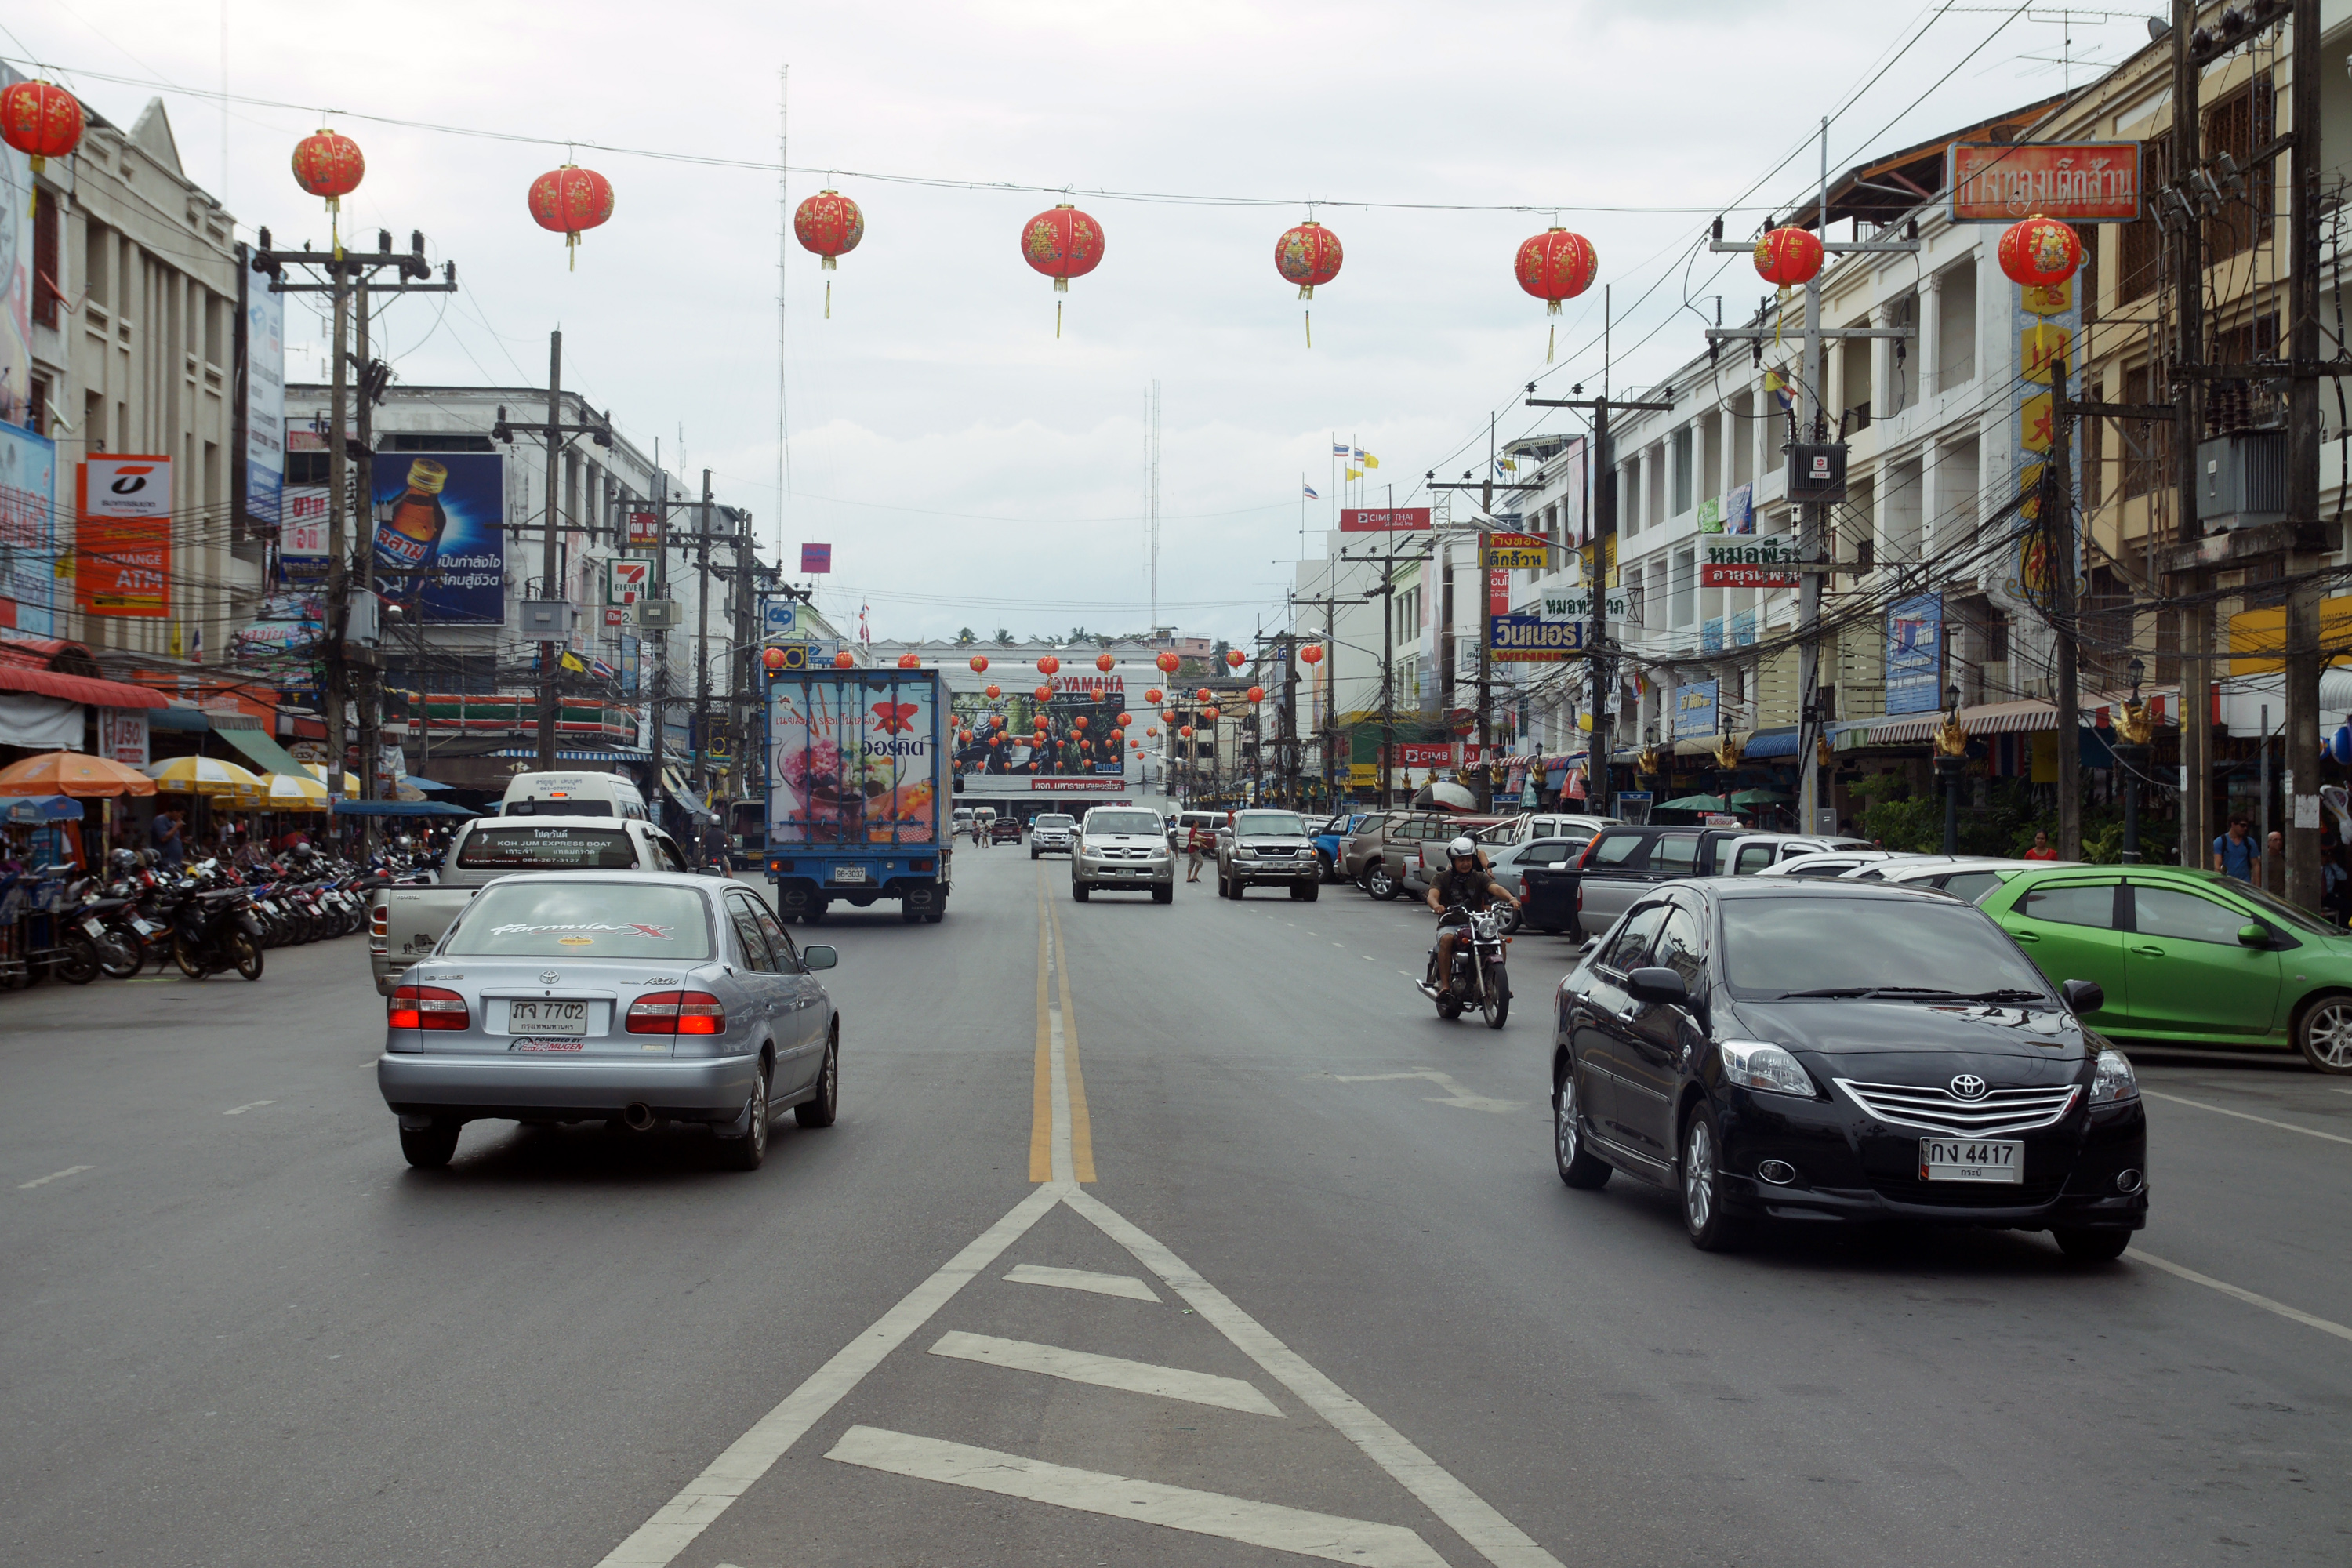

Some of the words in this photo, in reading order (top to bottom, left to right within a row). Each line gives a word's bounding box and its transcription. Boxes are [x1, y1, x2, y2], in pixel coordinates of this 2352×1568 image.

[376, 527, 428, 560] ฉลาม
[437, 553, 502, 568] เป็นกำลังใจ
[115, 569, 163, 589] ATM
[617, 564, 644, 604] 7
[615, 583, 644, 592] ELEVE
[607, 611, 621, 621] เปิด
[1496, 652, 1572, 662] WINNE
[1062, 676, 1124, 693] YAMAHA
[290, 747, 316, 760] Easy
[1420, 751, 1449, 760] CIMB
[837, 869, 864, 878] 96-3037
[544, 1003, 584, 1020] 7702
[521, 1022, 575, 1033] กรุงเทพมหานคร
[1930, 1142, 1958, 1163] กง
[1965, 1144, 2013, 1165] 4417
[1960, 1167, 1982, 1178] กระบี่
